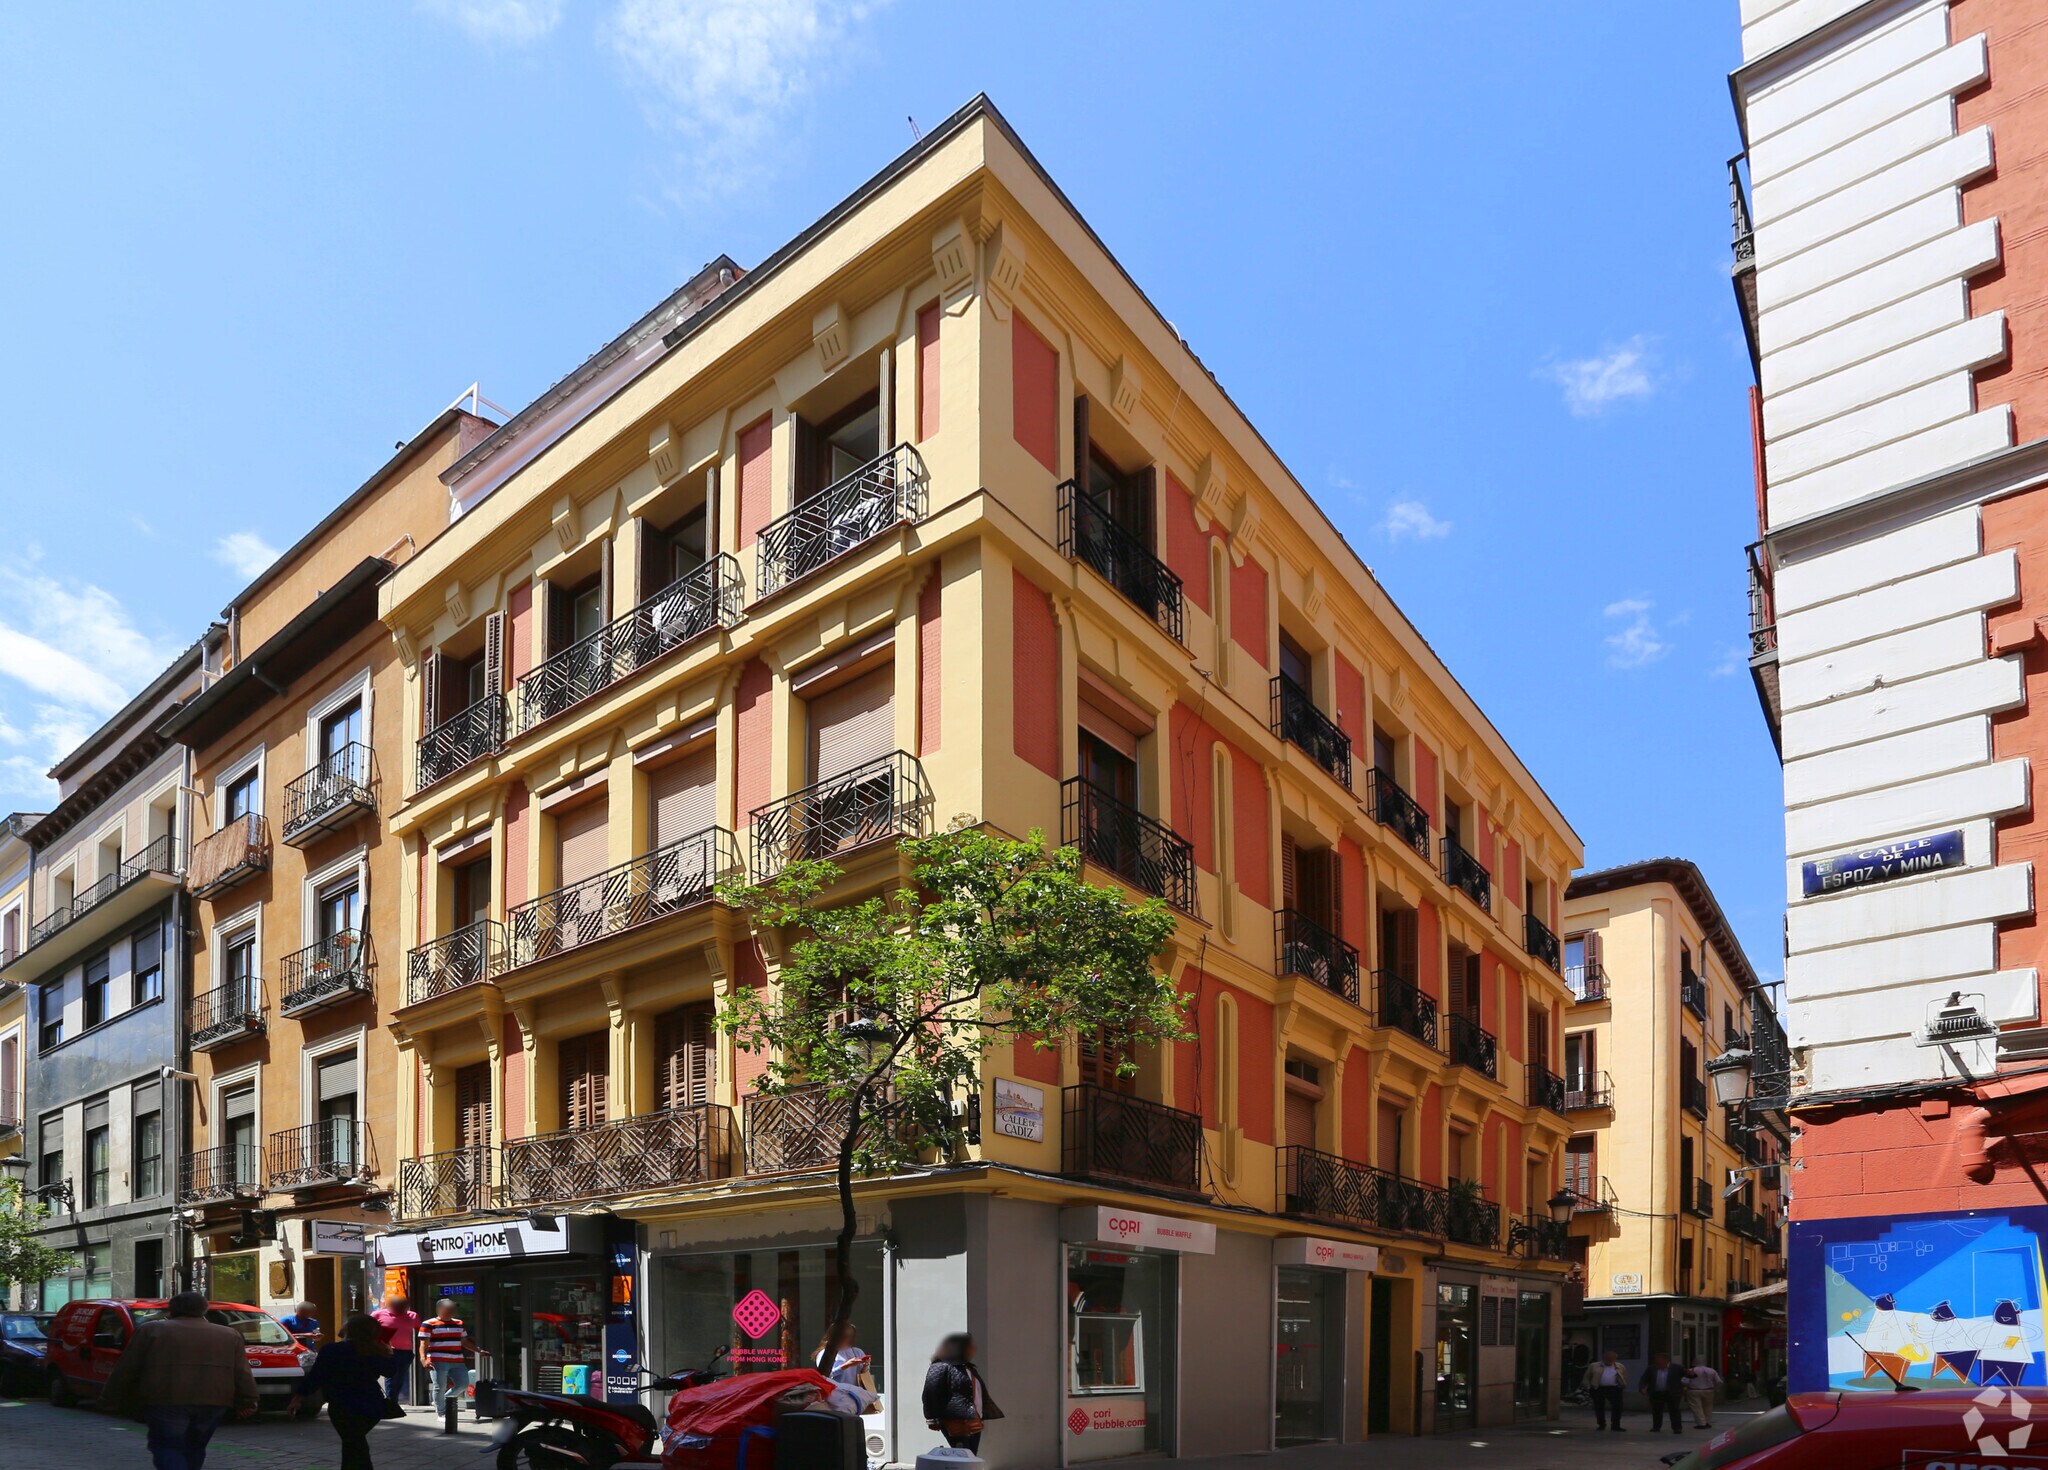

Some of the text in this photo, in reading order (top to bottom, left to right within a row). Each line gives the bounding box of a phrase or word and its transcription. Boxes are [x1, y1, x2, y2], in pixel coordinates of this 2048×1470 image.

[1859, 838, 1931, 860] CALLE
[1883, 851, 1903, 861] DE
[1822, 853, 1943, 889] ESPOZ Y MINA
[1002, 1114, 1028, 1126] CALLE
[1109, 1218, 1192, 1239] CORI BUBBLE WAFFLE
[474, 1246, 507, 1254] MADRID
[1316, 1247, 1334, 1257] CORI
[1093, 1408, 1111, 1418] cori
[1093, 1418, 1147, 1430] bubble.com
